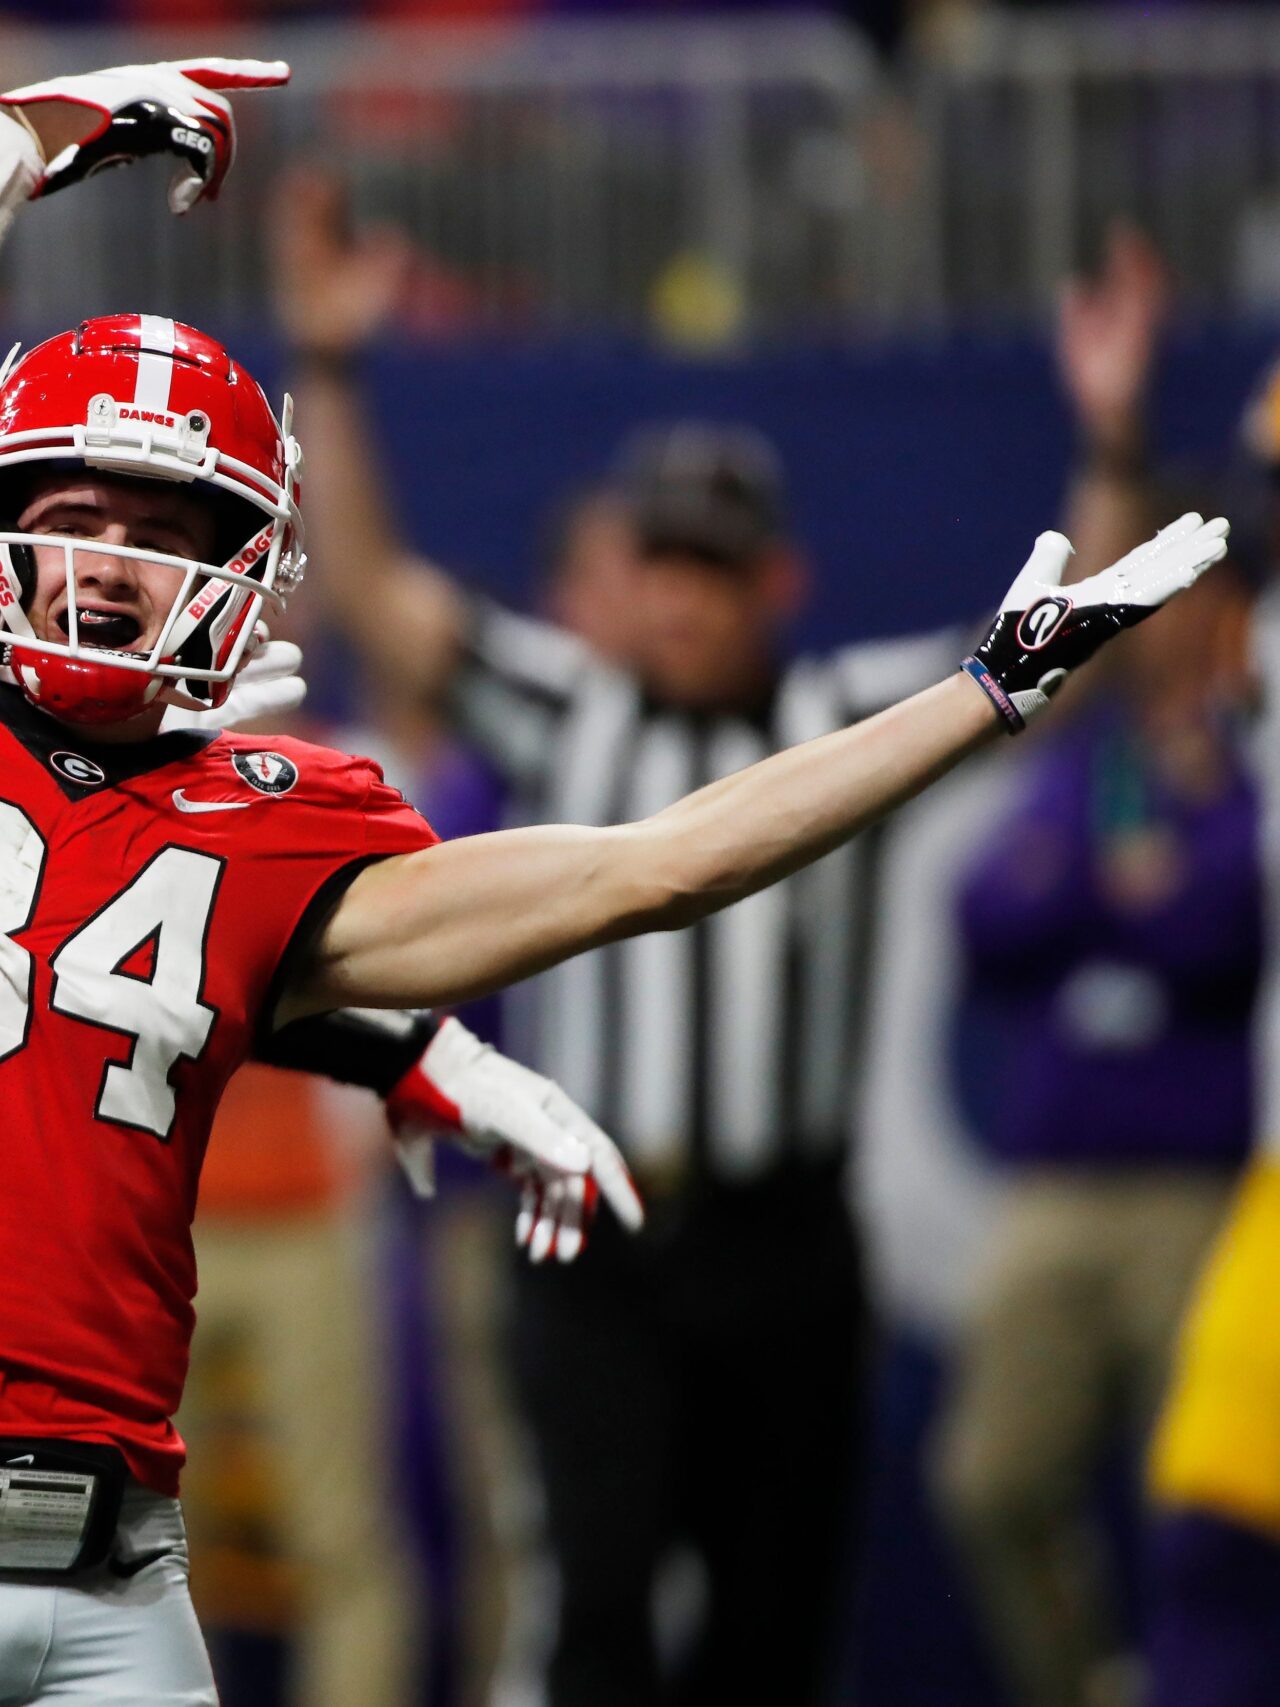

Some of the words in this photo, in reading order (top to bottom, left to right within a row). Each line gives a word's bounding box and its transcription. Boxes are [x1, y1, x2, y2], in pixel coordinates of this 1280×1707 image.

[171, 127, 212, 154] GEO
[119, 407, 175, 428] DAWGS
[50, 751, 105, 785] G
